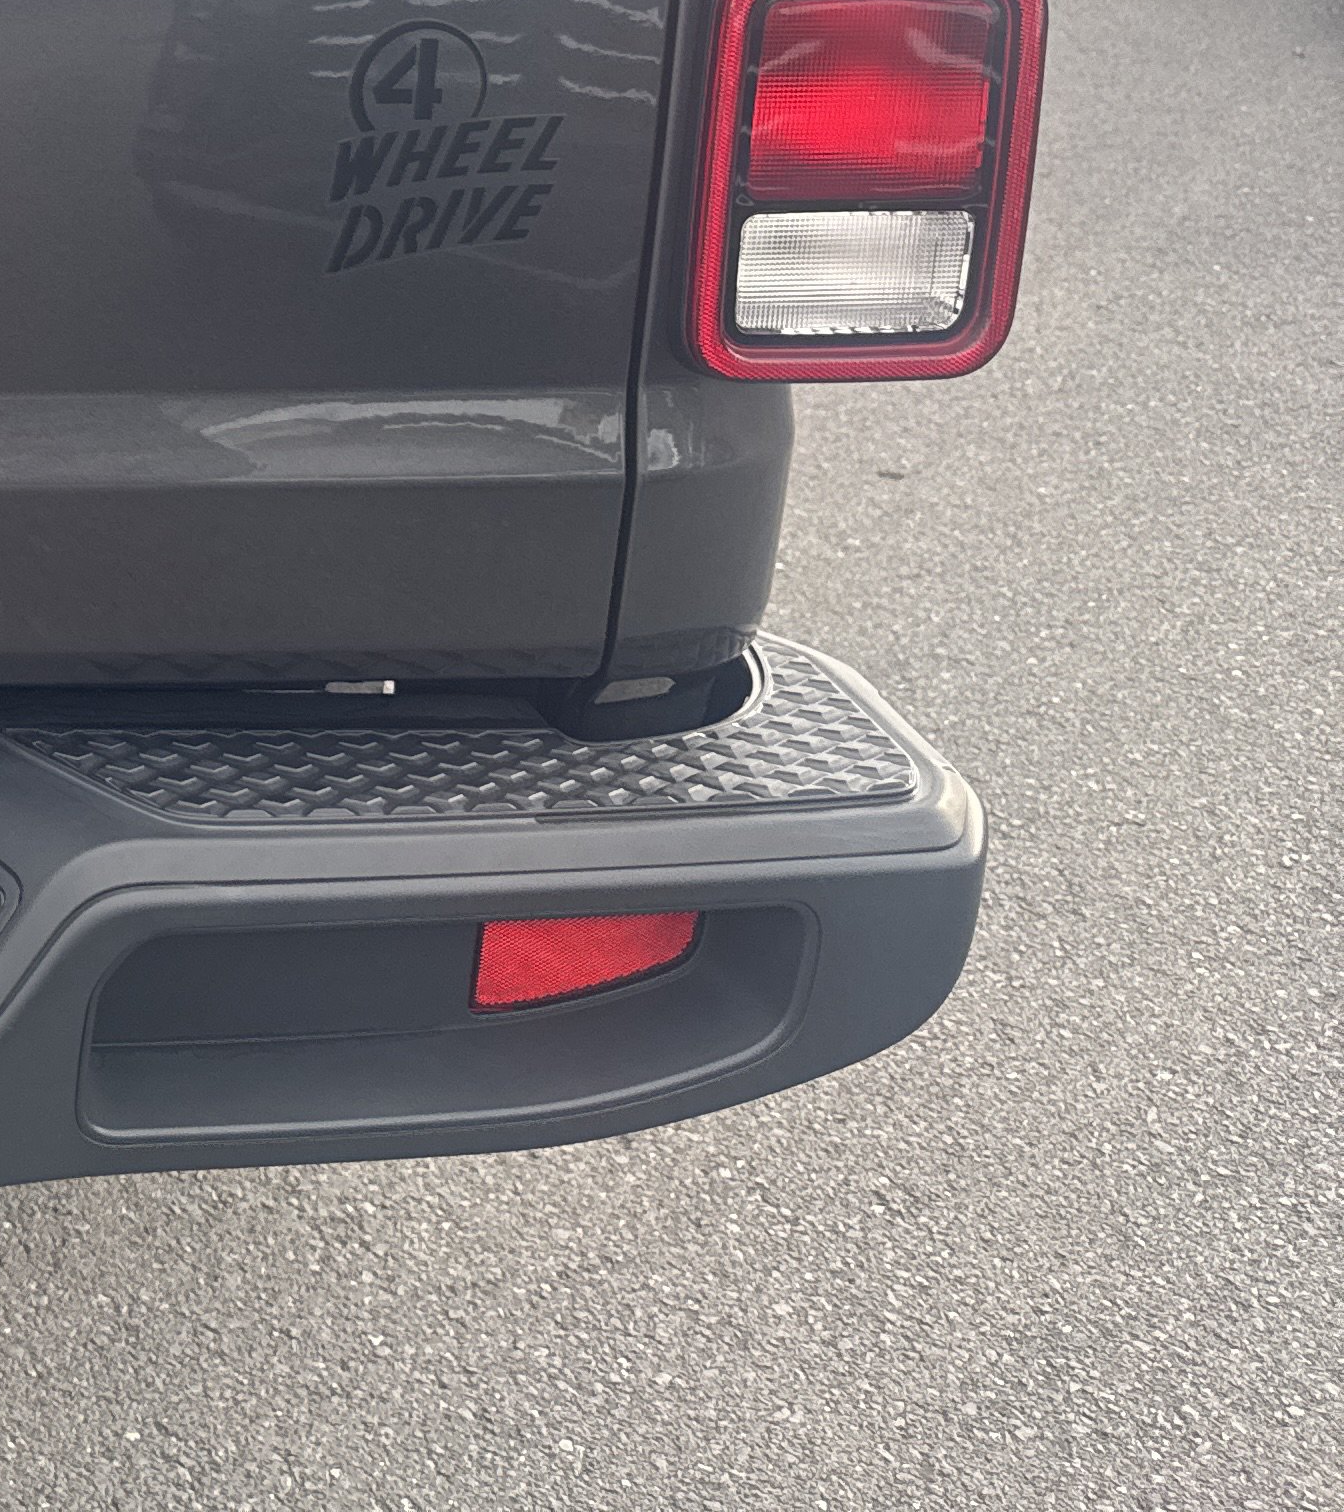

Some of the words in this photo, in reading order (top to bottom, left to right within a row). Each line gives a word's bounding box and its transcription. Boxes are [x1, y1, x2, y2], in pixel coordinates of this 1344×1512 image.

[372, 37, 443, 120] 4
[329, 115, 565, 203] WHEEL
[324, 183, 554, 274] DRIVE
